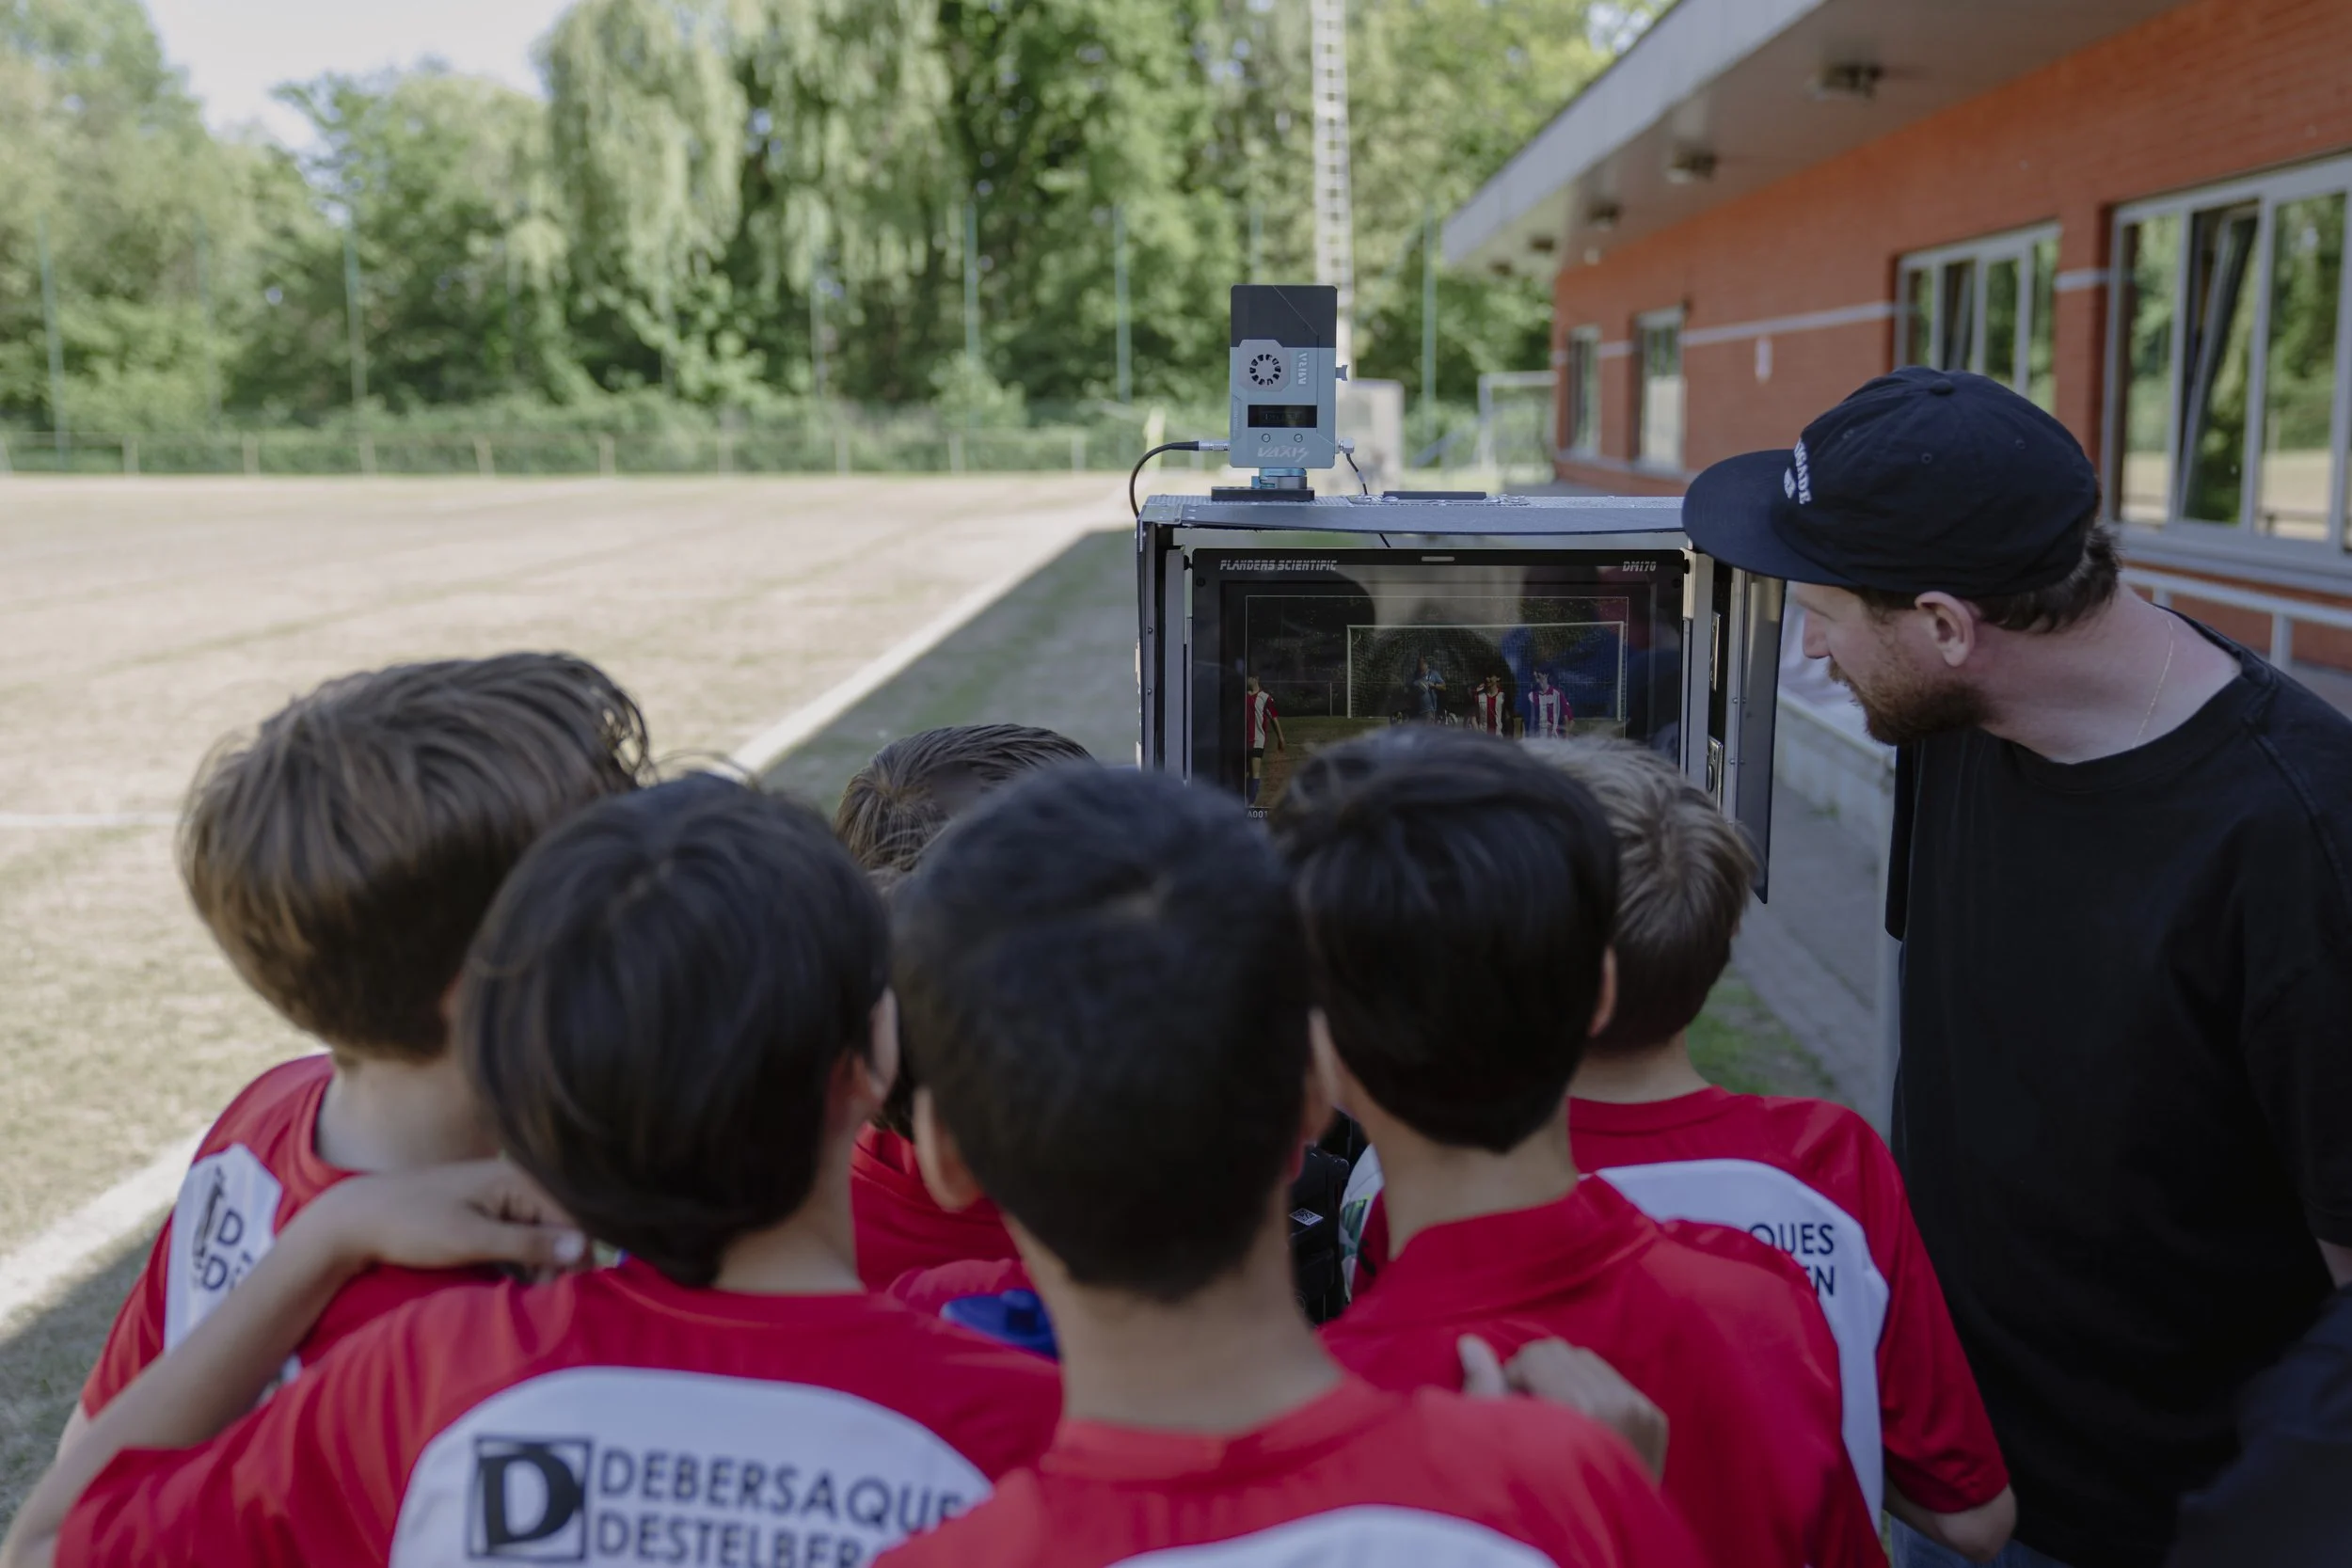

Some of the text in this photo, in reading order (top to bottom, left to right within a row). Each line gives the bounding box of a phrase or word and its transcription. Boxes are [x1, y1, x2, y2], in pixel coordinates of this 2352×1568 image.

[1298, 353, 1309, 385] MIRA
[1220, 560, 1337, 571] FLANDERS SCIENTIFIC
[1622, 562, 1657, 572] DM170
[1803, 1265, 1835, 1296] N
